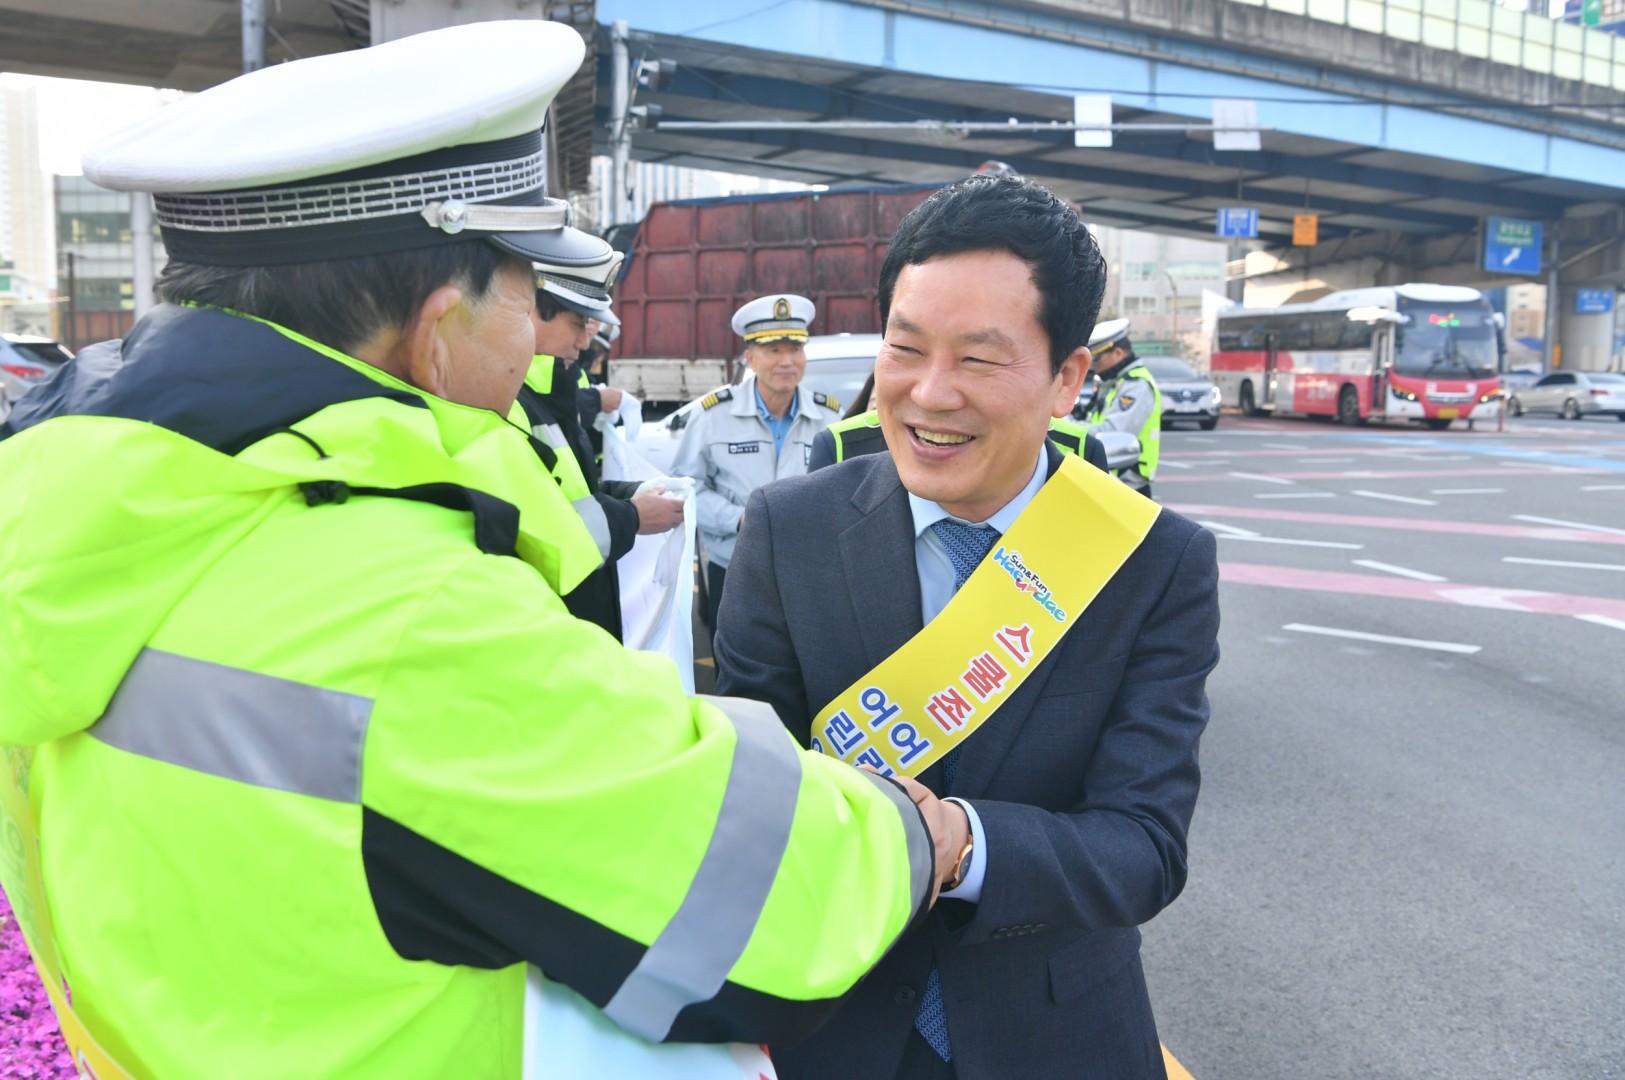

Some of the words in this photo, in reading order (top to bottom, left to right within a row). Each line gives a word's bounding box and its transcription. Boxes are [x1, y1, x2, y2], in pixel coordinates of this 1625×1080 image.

[993, 546, 1066, 622] Haeundae
[1010, 554, 1049, 594] Sun&Fun
[926, 625, 1031, 732] 스쿨존
